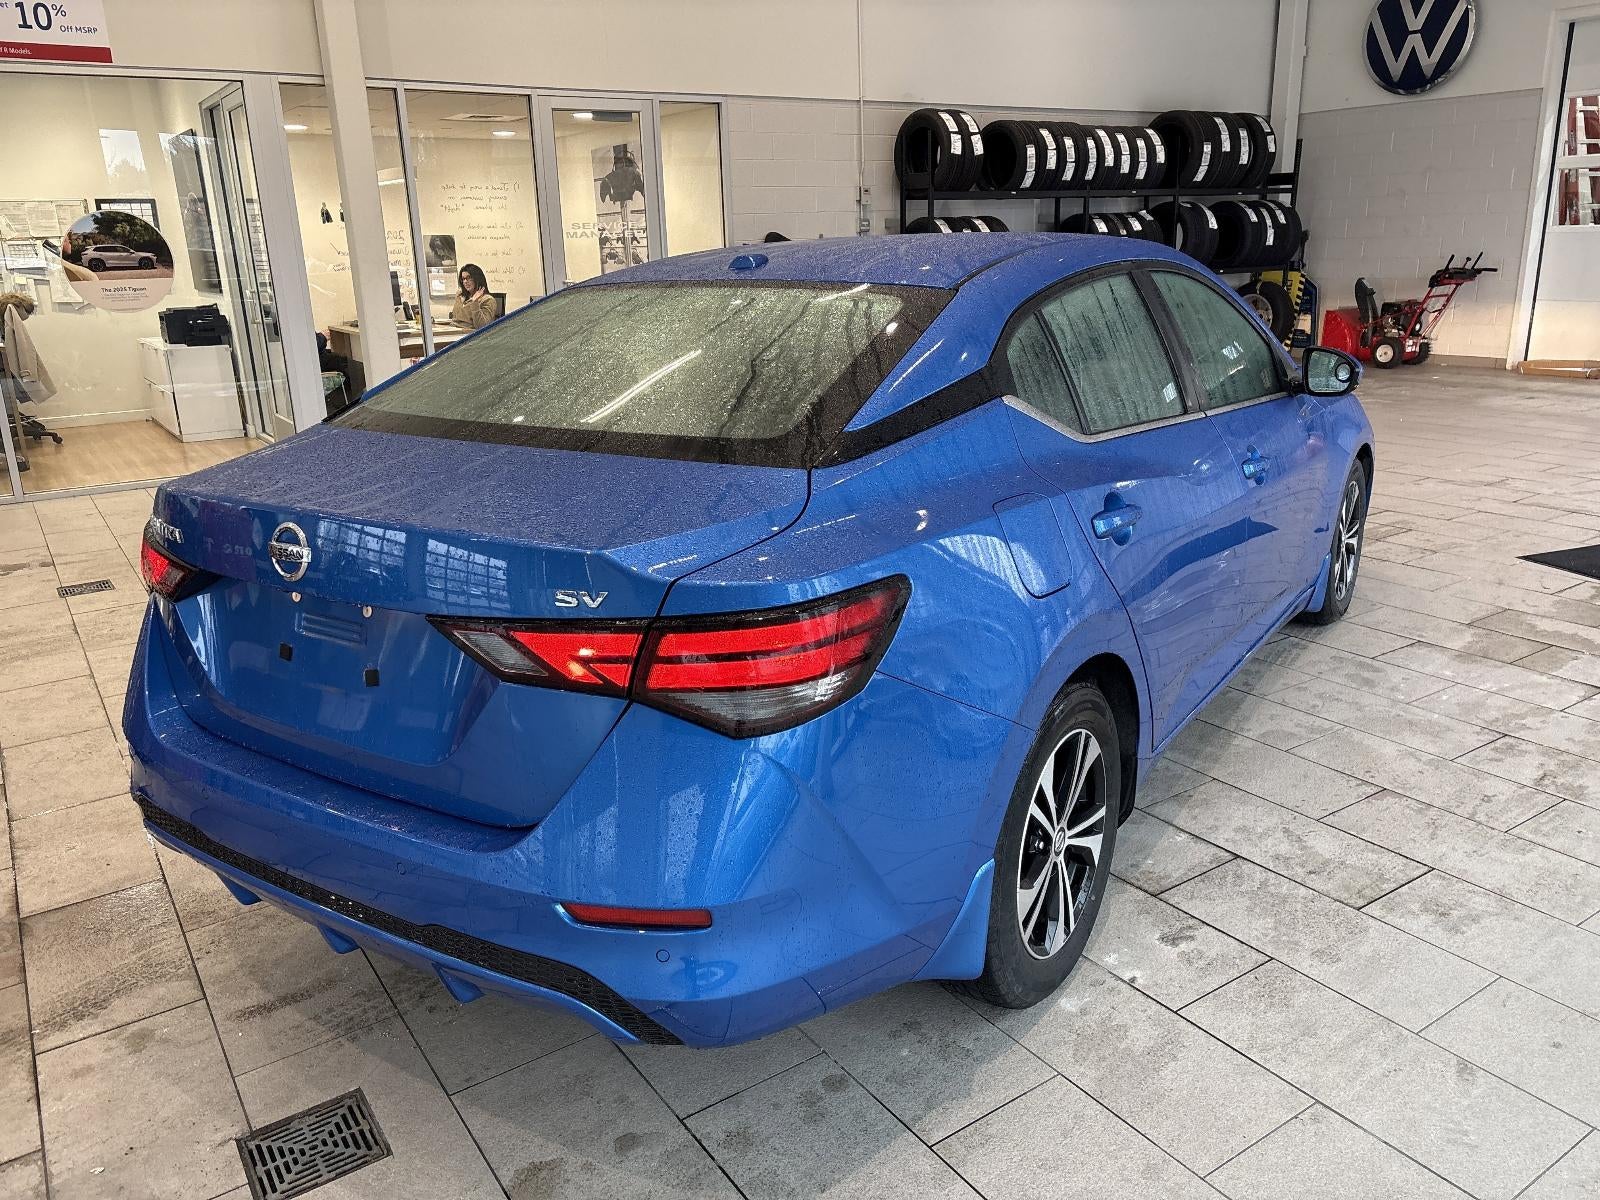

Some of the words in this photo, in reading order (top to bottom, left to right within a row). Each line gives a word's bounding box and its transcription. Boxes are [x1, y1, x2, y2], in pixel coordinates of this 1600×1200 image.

[60, 24, 73, 33] Off
[75, 26, 98, 35] MSRP
[555, 590, 609, 608] SV
